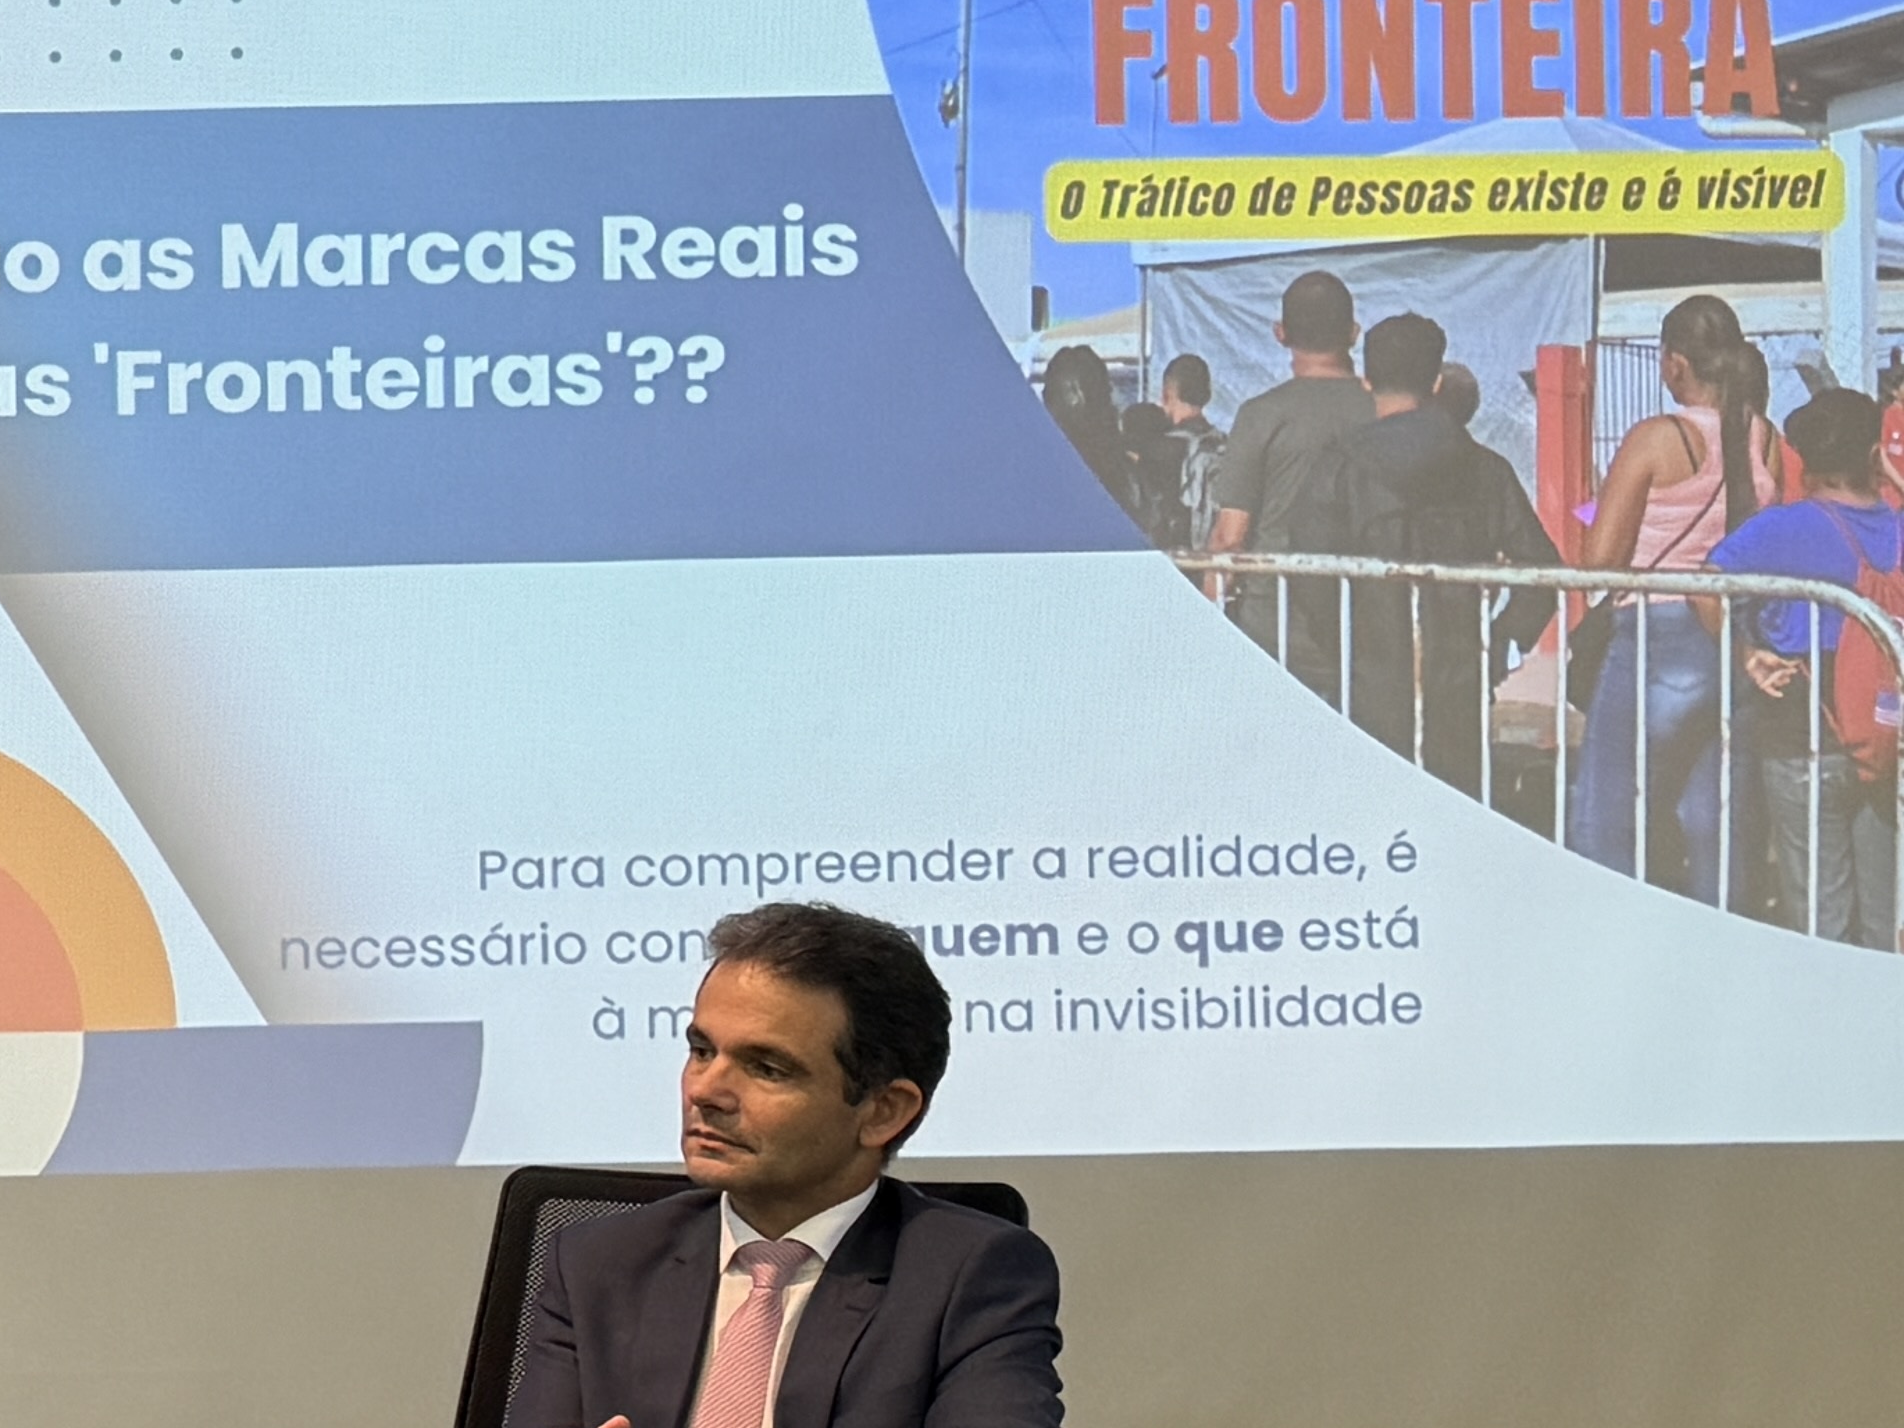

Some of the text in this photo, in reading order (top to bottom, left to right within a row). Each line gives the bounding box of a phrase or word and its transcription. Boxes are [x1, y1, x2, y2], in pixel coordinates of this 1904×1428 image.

[1060, 165, 1827, 220] O Tráfico de Pessoas existe e é visível
[83, 237, 194, 291] as
[221, 222, 576, 289] Marcas
[602, 202, 859, 281] Reais
[94, 330, 726, 416] 'Fronteiras'??
[479, 829, 1418, 898] Para compreender a realidade, é
[280, 921, 587, 970] necessário
[1077, 920, 1109, 955] e
[1127, 920, 1160, 955] o
[1175, 916, 1284, 969] que
[1299, 904, 1420, 951] está
[591, 995, 627, 1041] à
[965, 981, 1424, 1033] na invisibilidade
